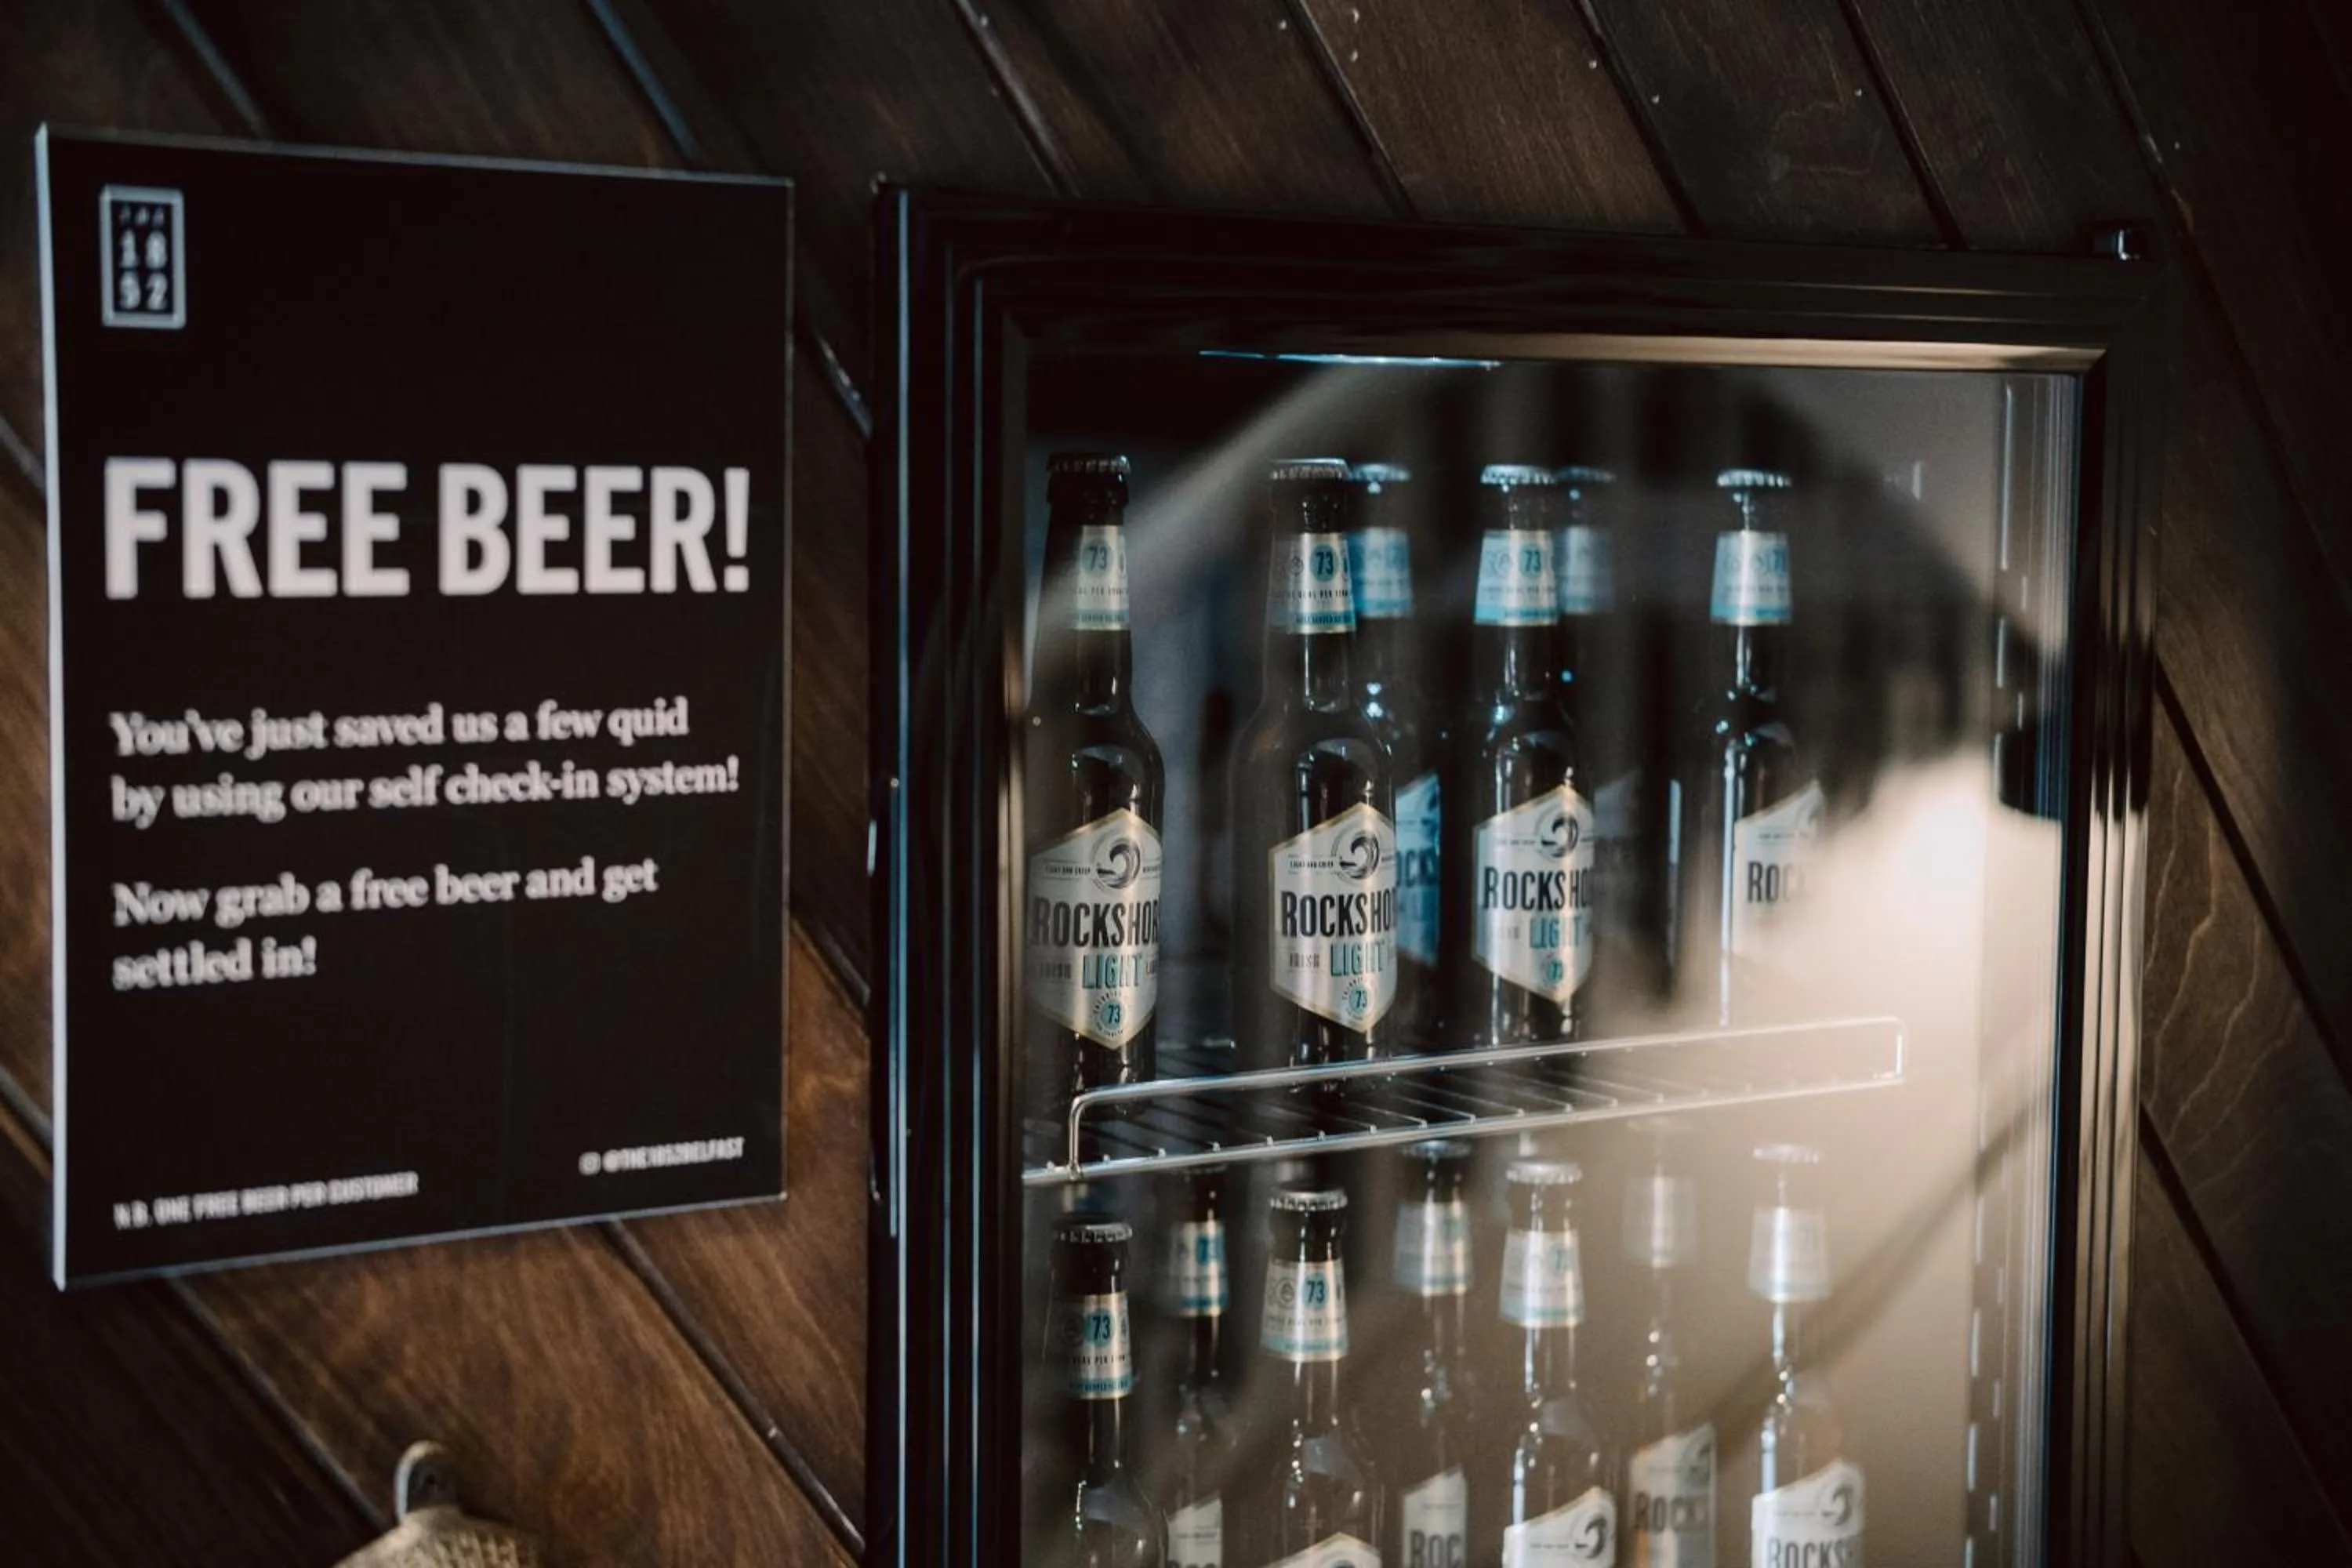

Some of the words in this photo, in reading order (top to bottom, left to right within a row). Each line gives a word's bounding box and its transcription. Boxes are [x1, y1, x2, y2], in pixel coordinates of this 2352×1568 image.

[104, 457, 410, 600] FREE
[438, 463, 750, 596] BEER!
[1087, 545, 1108, 571] 73
[1315, 550, 1334, 576] 73
[111, 709, 245, 756] You've
[245, 707, 328, 760] just
[333, 702, 445, 748] saved
[452, 712, 499, 743] us
[503, 711, 530, 742] a
[535, 699, 604, 741] few
[607, 695, 690, 747] quid
[111, 775, 165, 829] by
[172, 772, 287, 824] using
[290, 779, 365, 812] our
[368, 764, 444, 808] self
[444, 760, 601, 805] check-in
[605, 754, 739, 805] system!
[114, 881, 210, 927] Now
[215, 872, 310, 929] grab
[315, 880, 343, 913] a
[350, 867, 429, 910] free
[434, 863, 521, 905] beer
[524, 855, 596, 899] and
[601, 858, 659, 903] get
[112, 937, 253, 990] settled
[261, 935, 317, 979] in!
[1081, 953, 1143, 989] LIGHT
[1330, 942, 1385, 977] LIGHT
[1107, 1004, 1121, 1024] 73
[192, 1190, 240, 1220] FREE
[1306, 1279, 1326, 1303] 73
[1091, 1314, 1111, 1340] 73
